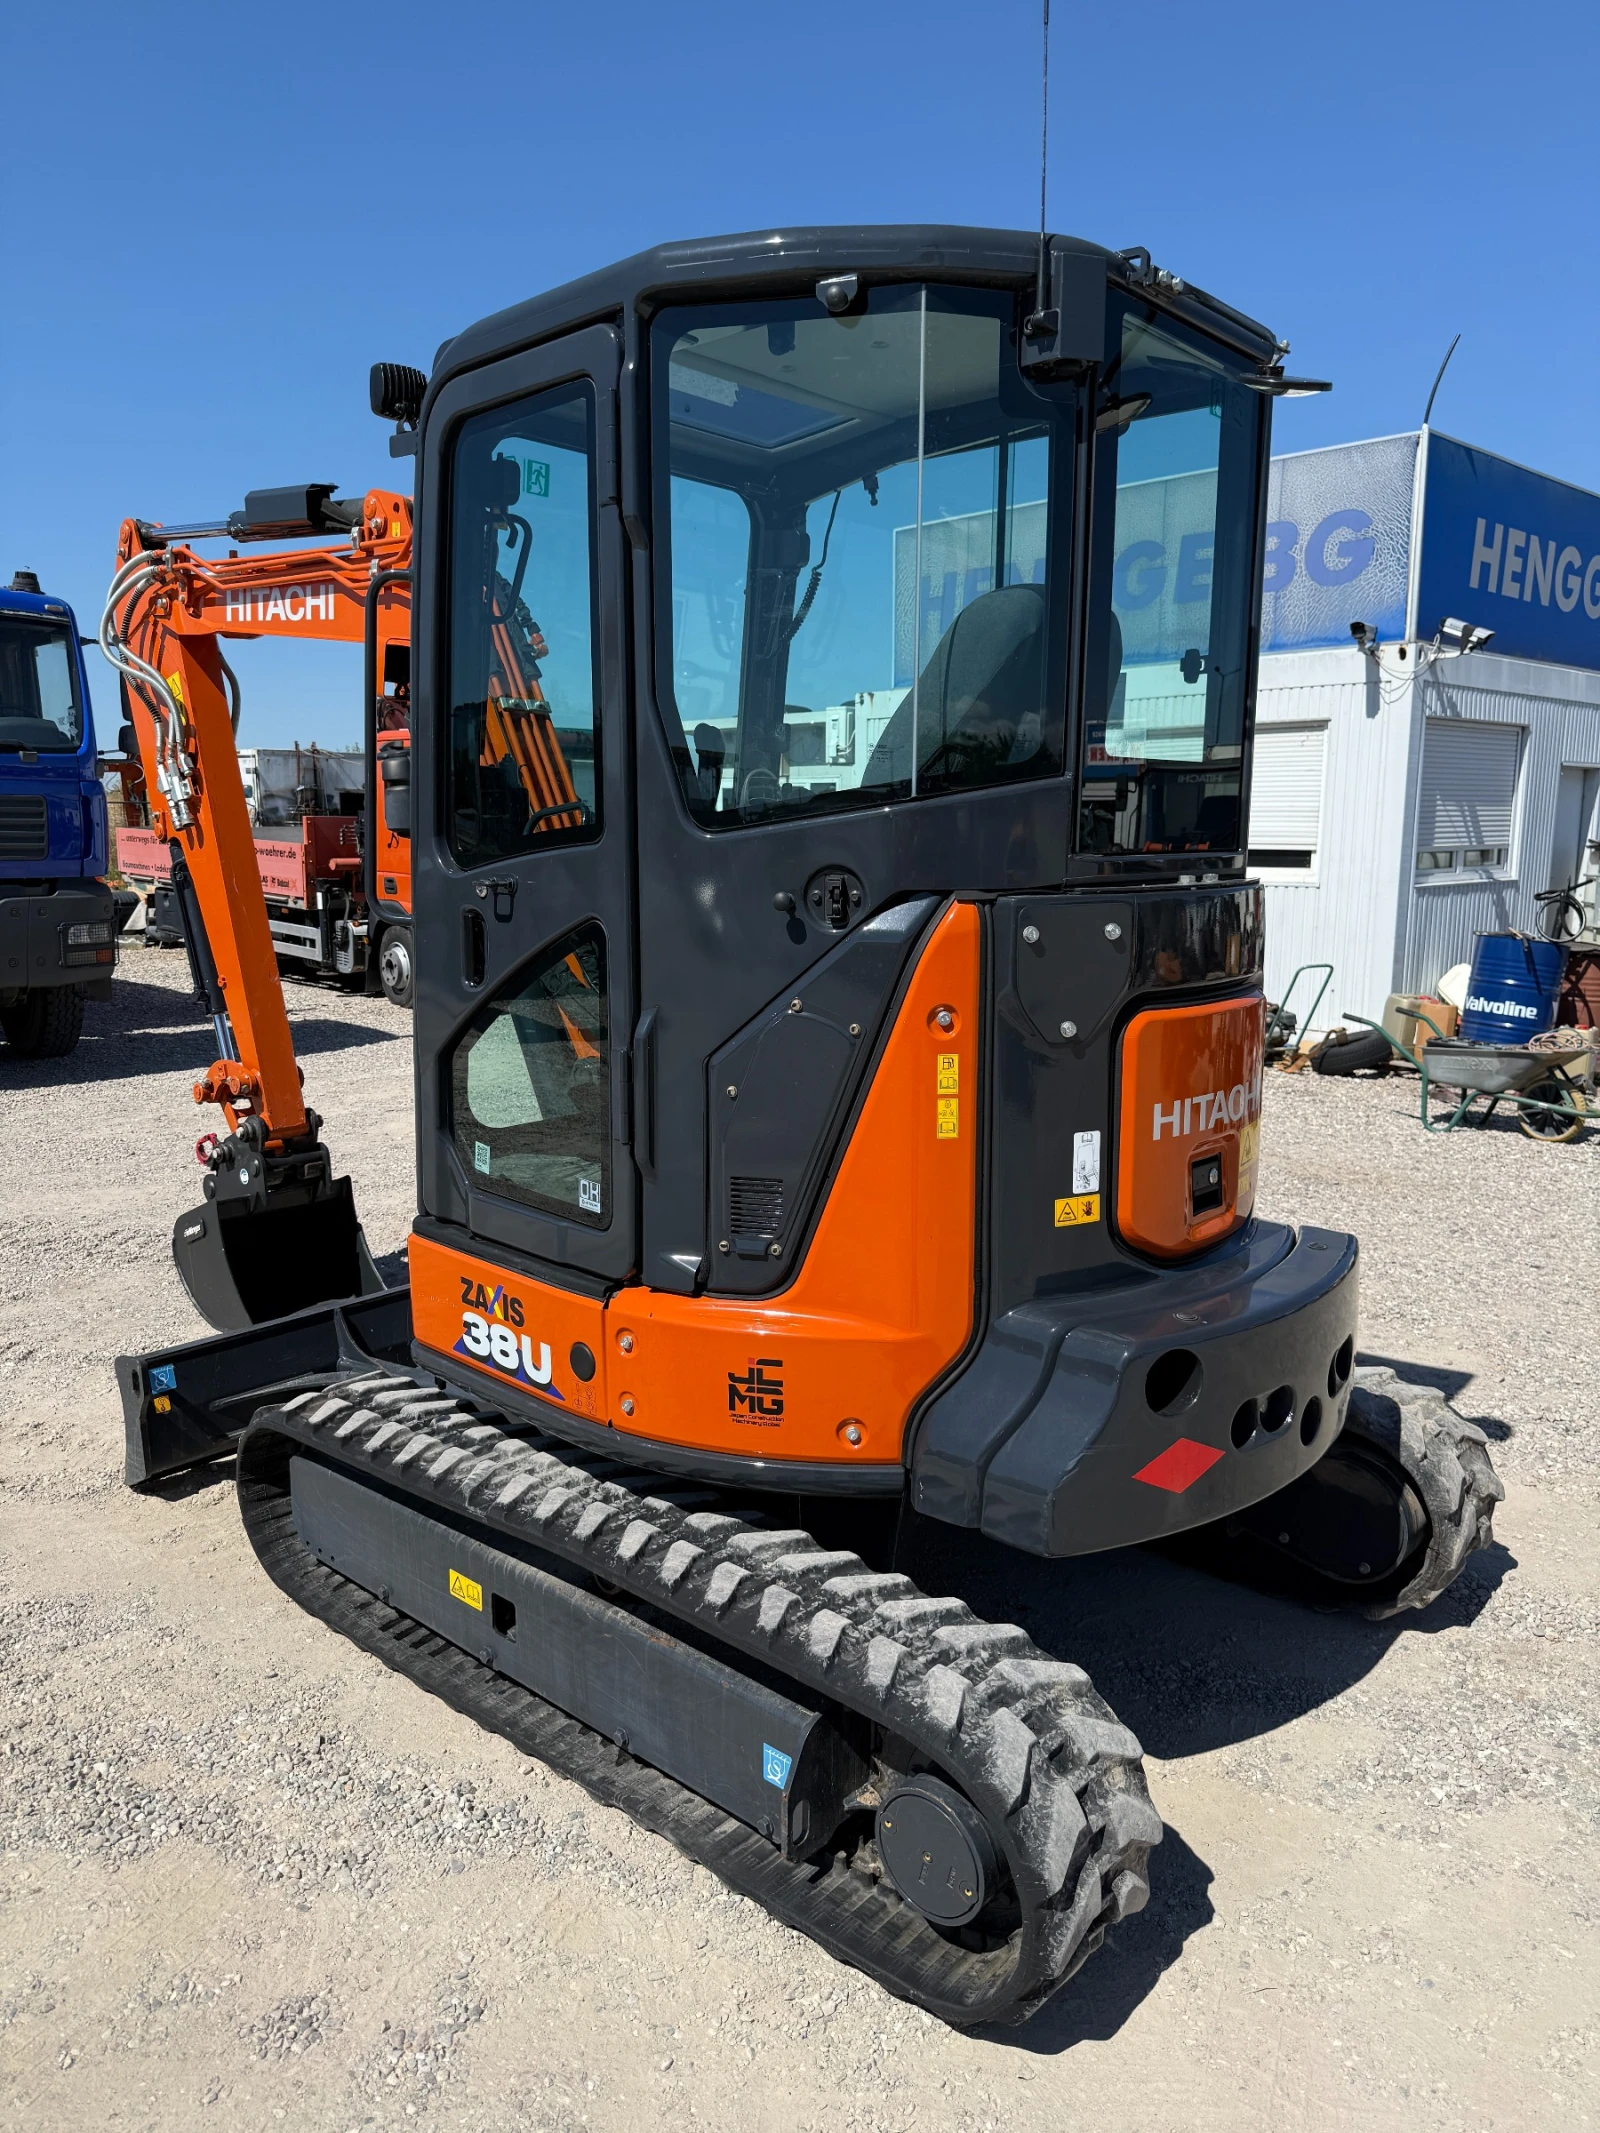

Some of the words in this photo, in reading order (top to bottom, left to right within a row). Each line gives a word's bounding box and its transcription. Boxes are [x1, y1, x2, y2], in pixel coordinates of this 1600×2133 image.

[226, 584, 335, 622] HITACHI
[1465, 995, 1537, 1019] Valvoline
[460, 1276, 525, 1328] ZAXIS
[462, 1311, 552, 1386] 38U
